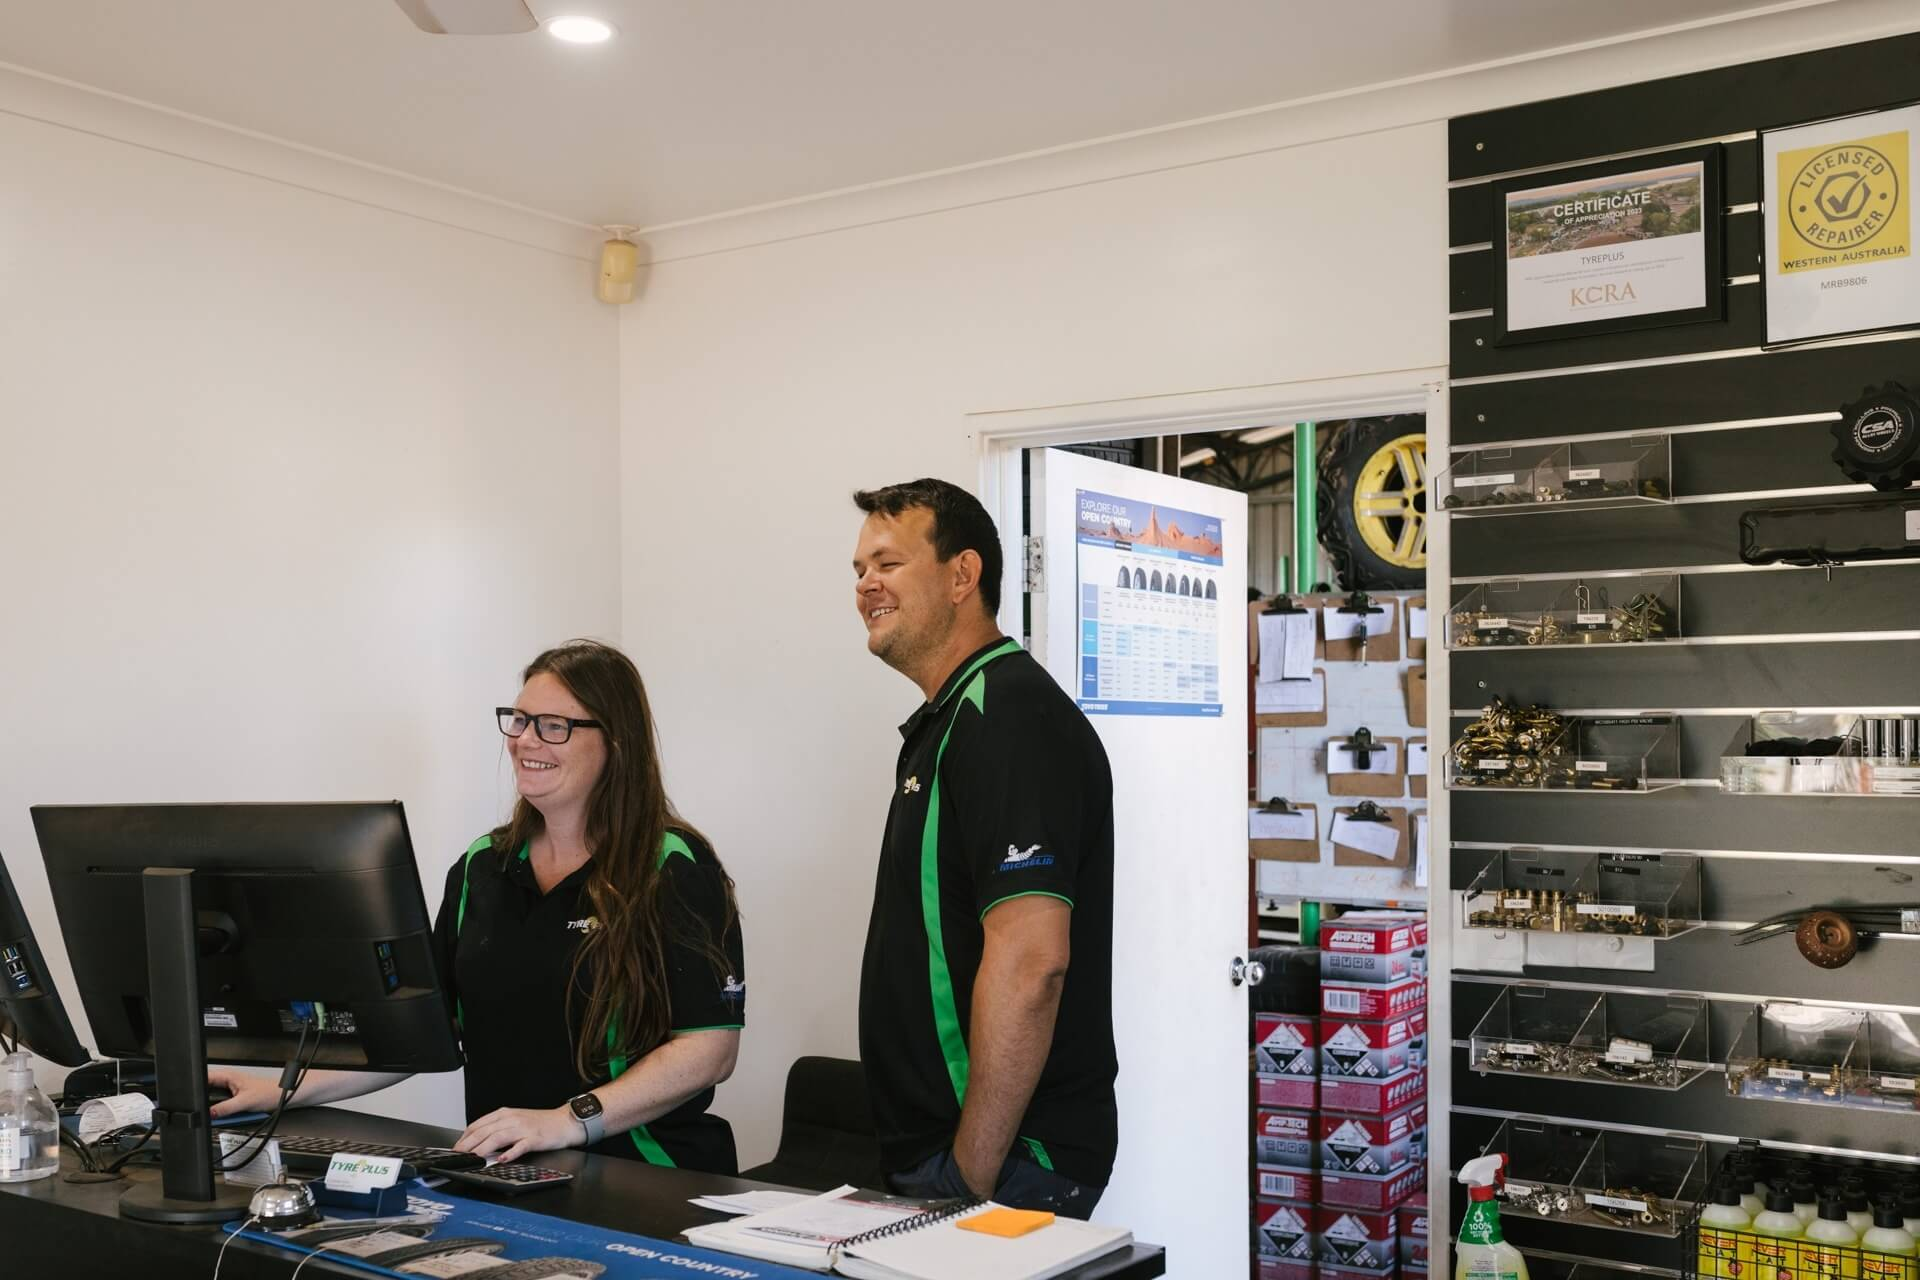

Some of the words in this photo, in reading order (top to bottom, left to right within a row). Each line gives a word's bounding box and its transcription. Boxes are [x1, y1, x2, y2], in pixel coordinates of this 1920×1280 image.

[1800, 151, 1885, 188] LICENSED
[1553, 191, 1652, 217] CERTIFICATE
[1564, 217, 1575, 225] OF
[1575, 209, 1626, 224] APPRECIATION
[1806, 210, 1885, 244] REPAIRER
[1581, 252, 1625, 265] TYREPLUS
[1783, 255, 1837, 269] WESTERN
[1842, 245, 1906, 261] AUSTRALIA
[1820, 276, 1868, 290] MRB9806
[1861, 420, 1894, 434] CSA
[1081, 499, 1111, 513] EXPLORE
[1081, 510, 1100, 523] OPEN
[1469, 1222, 1492, 1232] 100%
[605, 1243, 662, 1259] OPEN
[659, 1255, 760, 1280] COUNTRY
